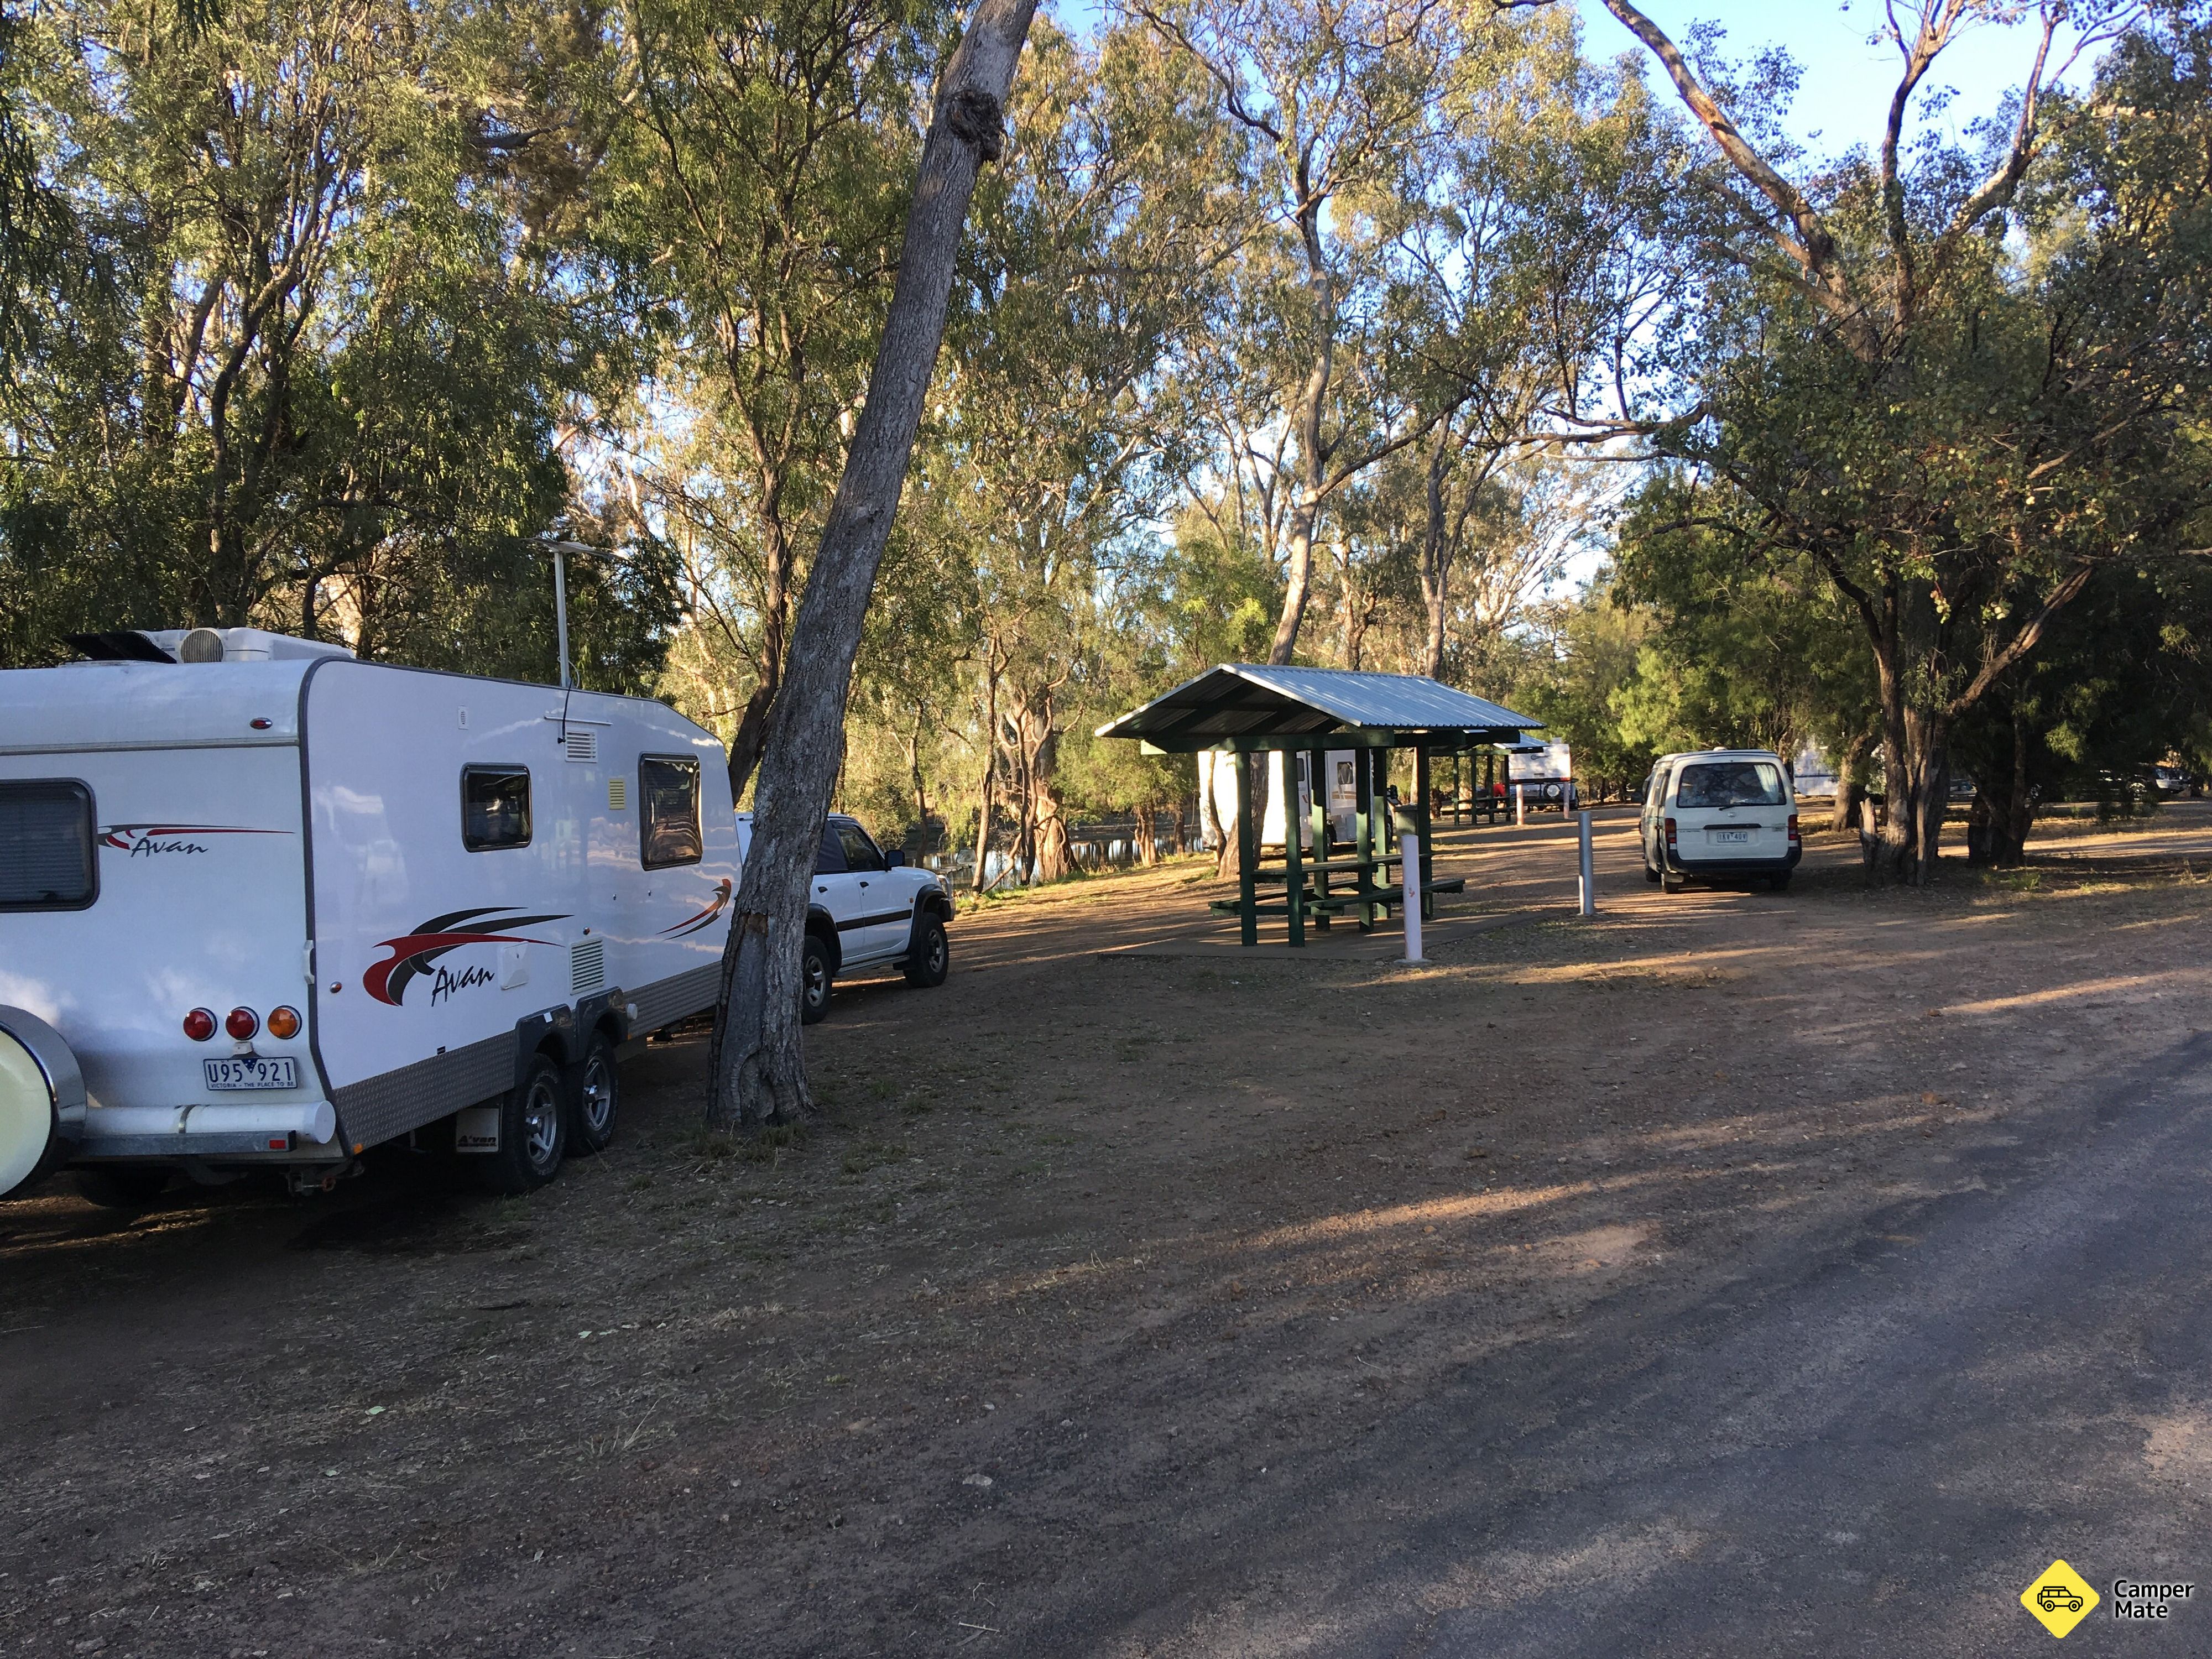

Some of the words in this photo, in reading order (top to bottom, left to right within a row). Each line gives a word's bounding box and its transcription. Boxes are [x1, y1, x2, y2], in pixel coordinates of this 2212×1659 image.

[131, 837, 208, 857] Avan
[431, 965, 495, 1007] Avan
[207, 1063, 243, 1083] U95
[257, 1062, 291, 1081] 921
